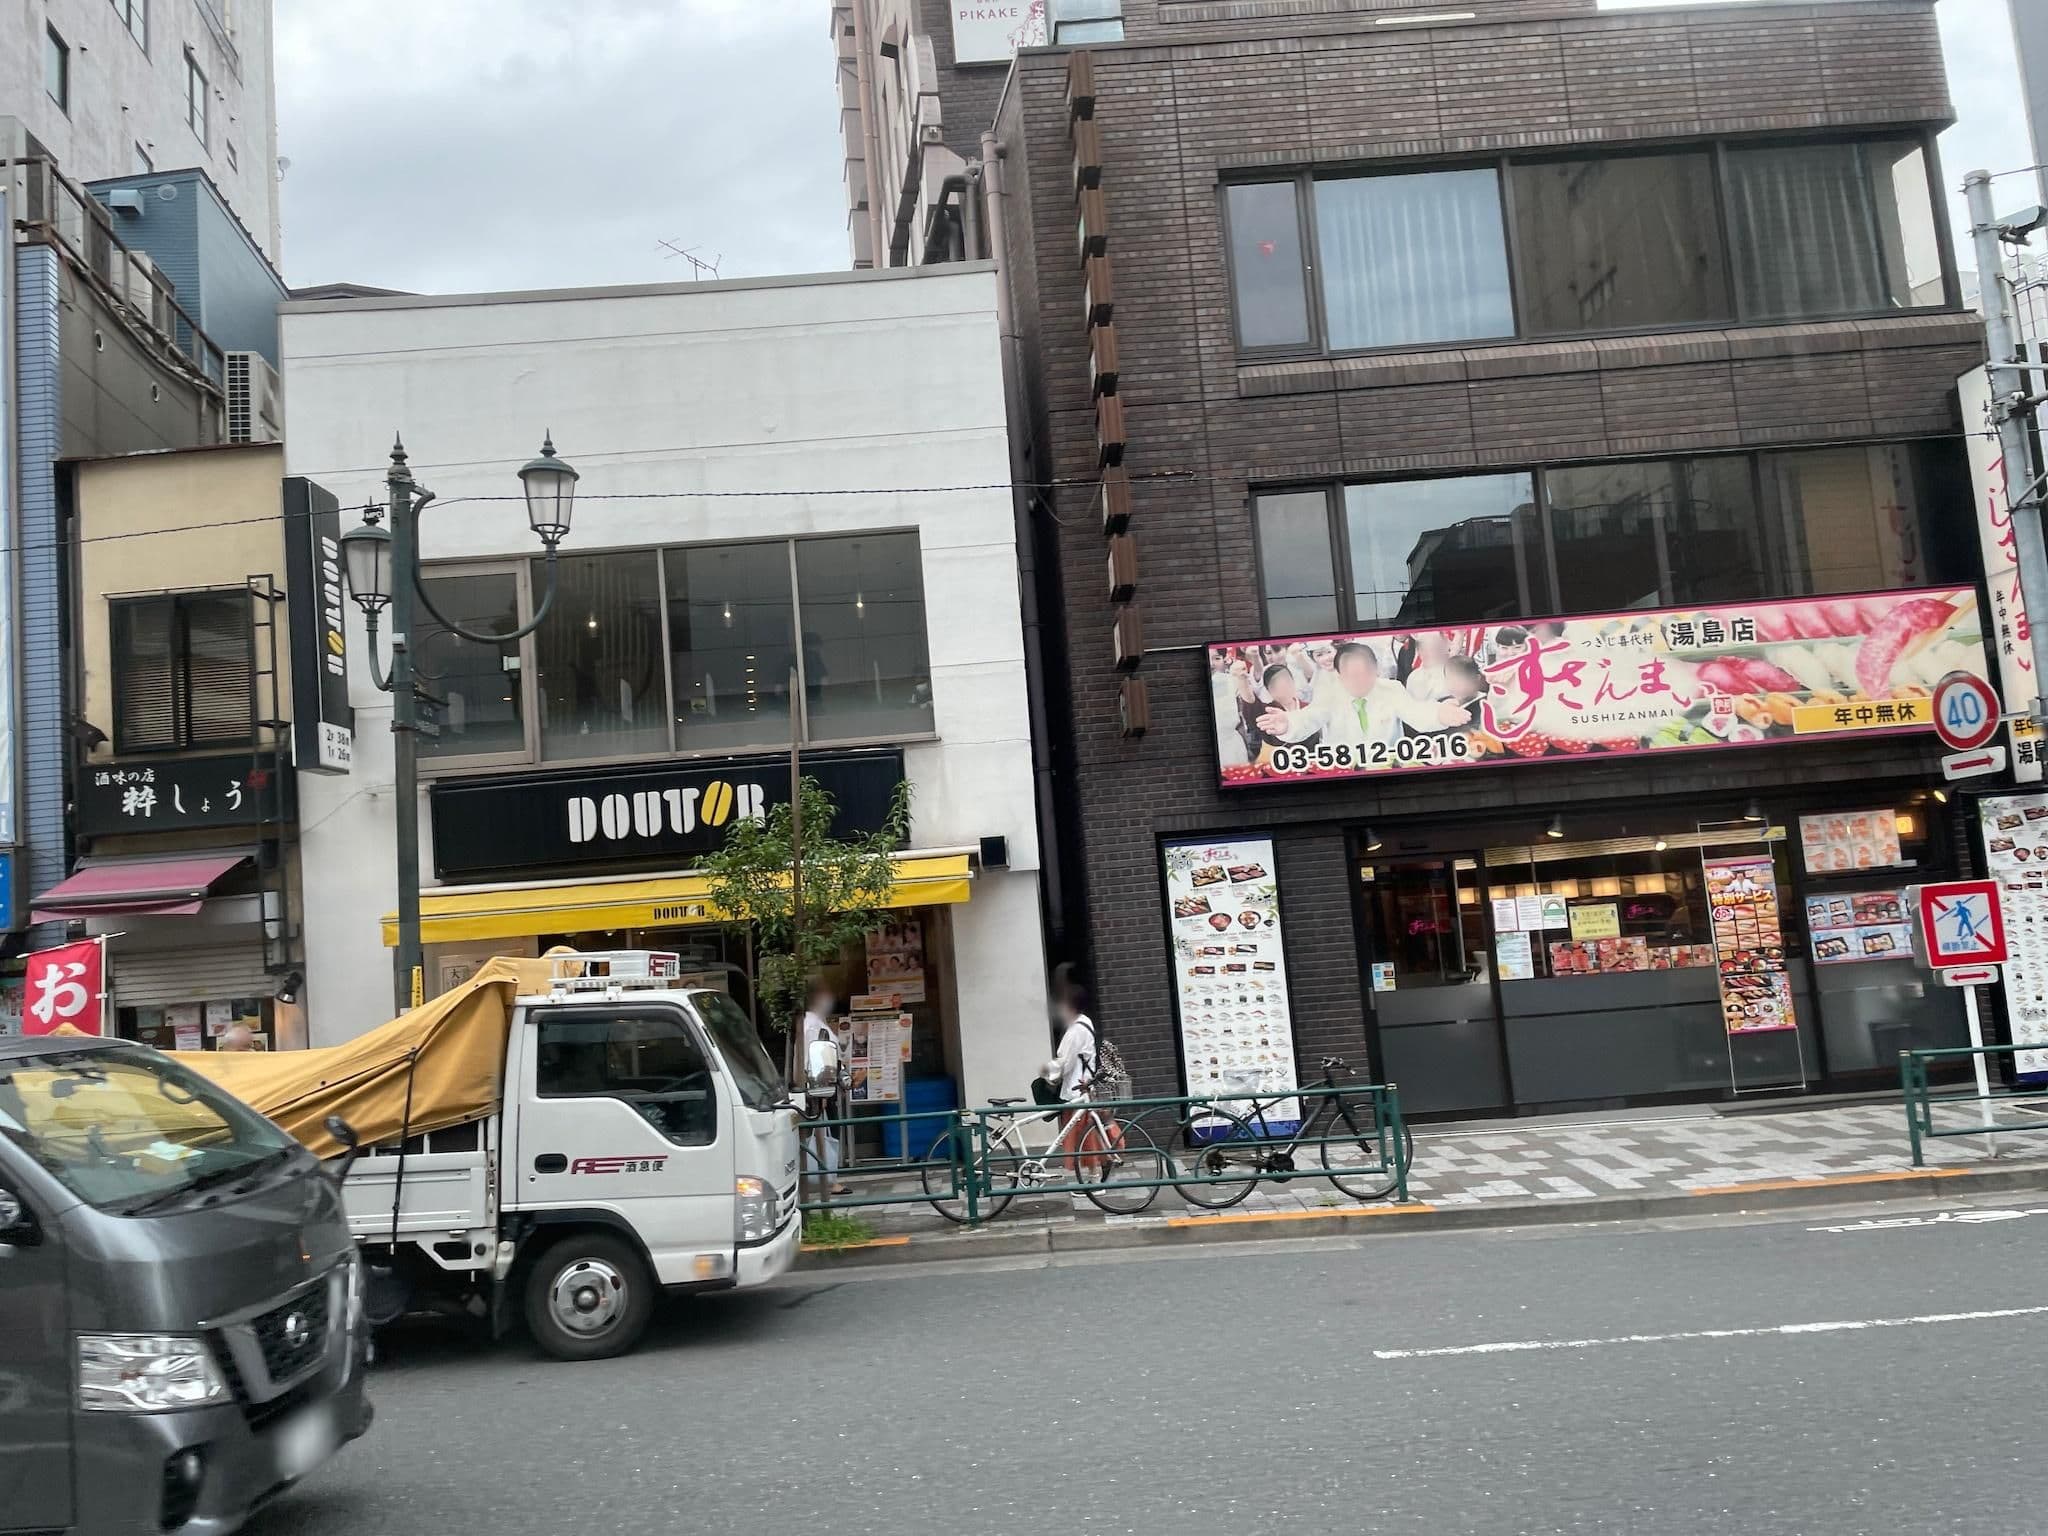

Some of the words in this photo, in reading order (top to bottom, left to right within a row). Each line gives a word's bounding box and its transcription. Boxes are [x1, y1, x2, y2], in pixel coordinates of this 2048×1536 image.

[960, 7, 1018, 20] PIKAKE
[321, 536, 344, 676] DOUTOR
[1670, 617, 1754, 648] 湯島店
[1995, 590, 2016, 655] 年中無休
[1581, 632, 1654, 649] つきじ喜代村
[1571, 708, 1675, 725] SUSHIZANMAI
[1834, 703, 1917, 726] 年中無休
[1947, 692, 1981, 728] 40
[1273, 736, 1467, 771] 03-5812-0216
[95, 768, 155, 786] 酒味の店
[567, 780, 766, 843] DOUTOR
[654, 904, 705, 920] DOUTOR
[31, 962, 88, 1024] お
